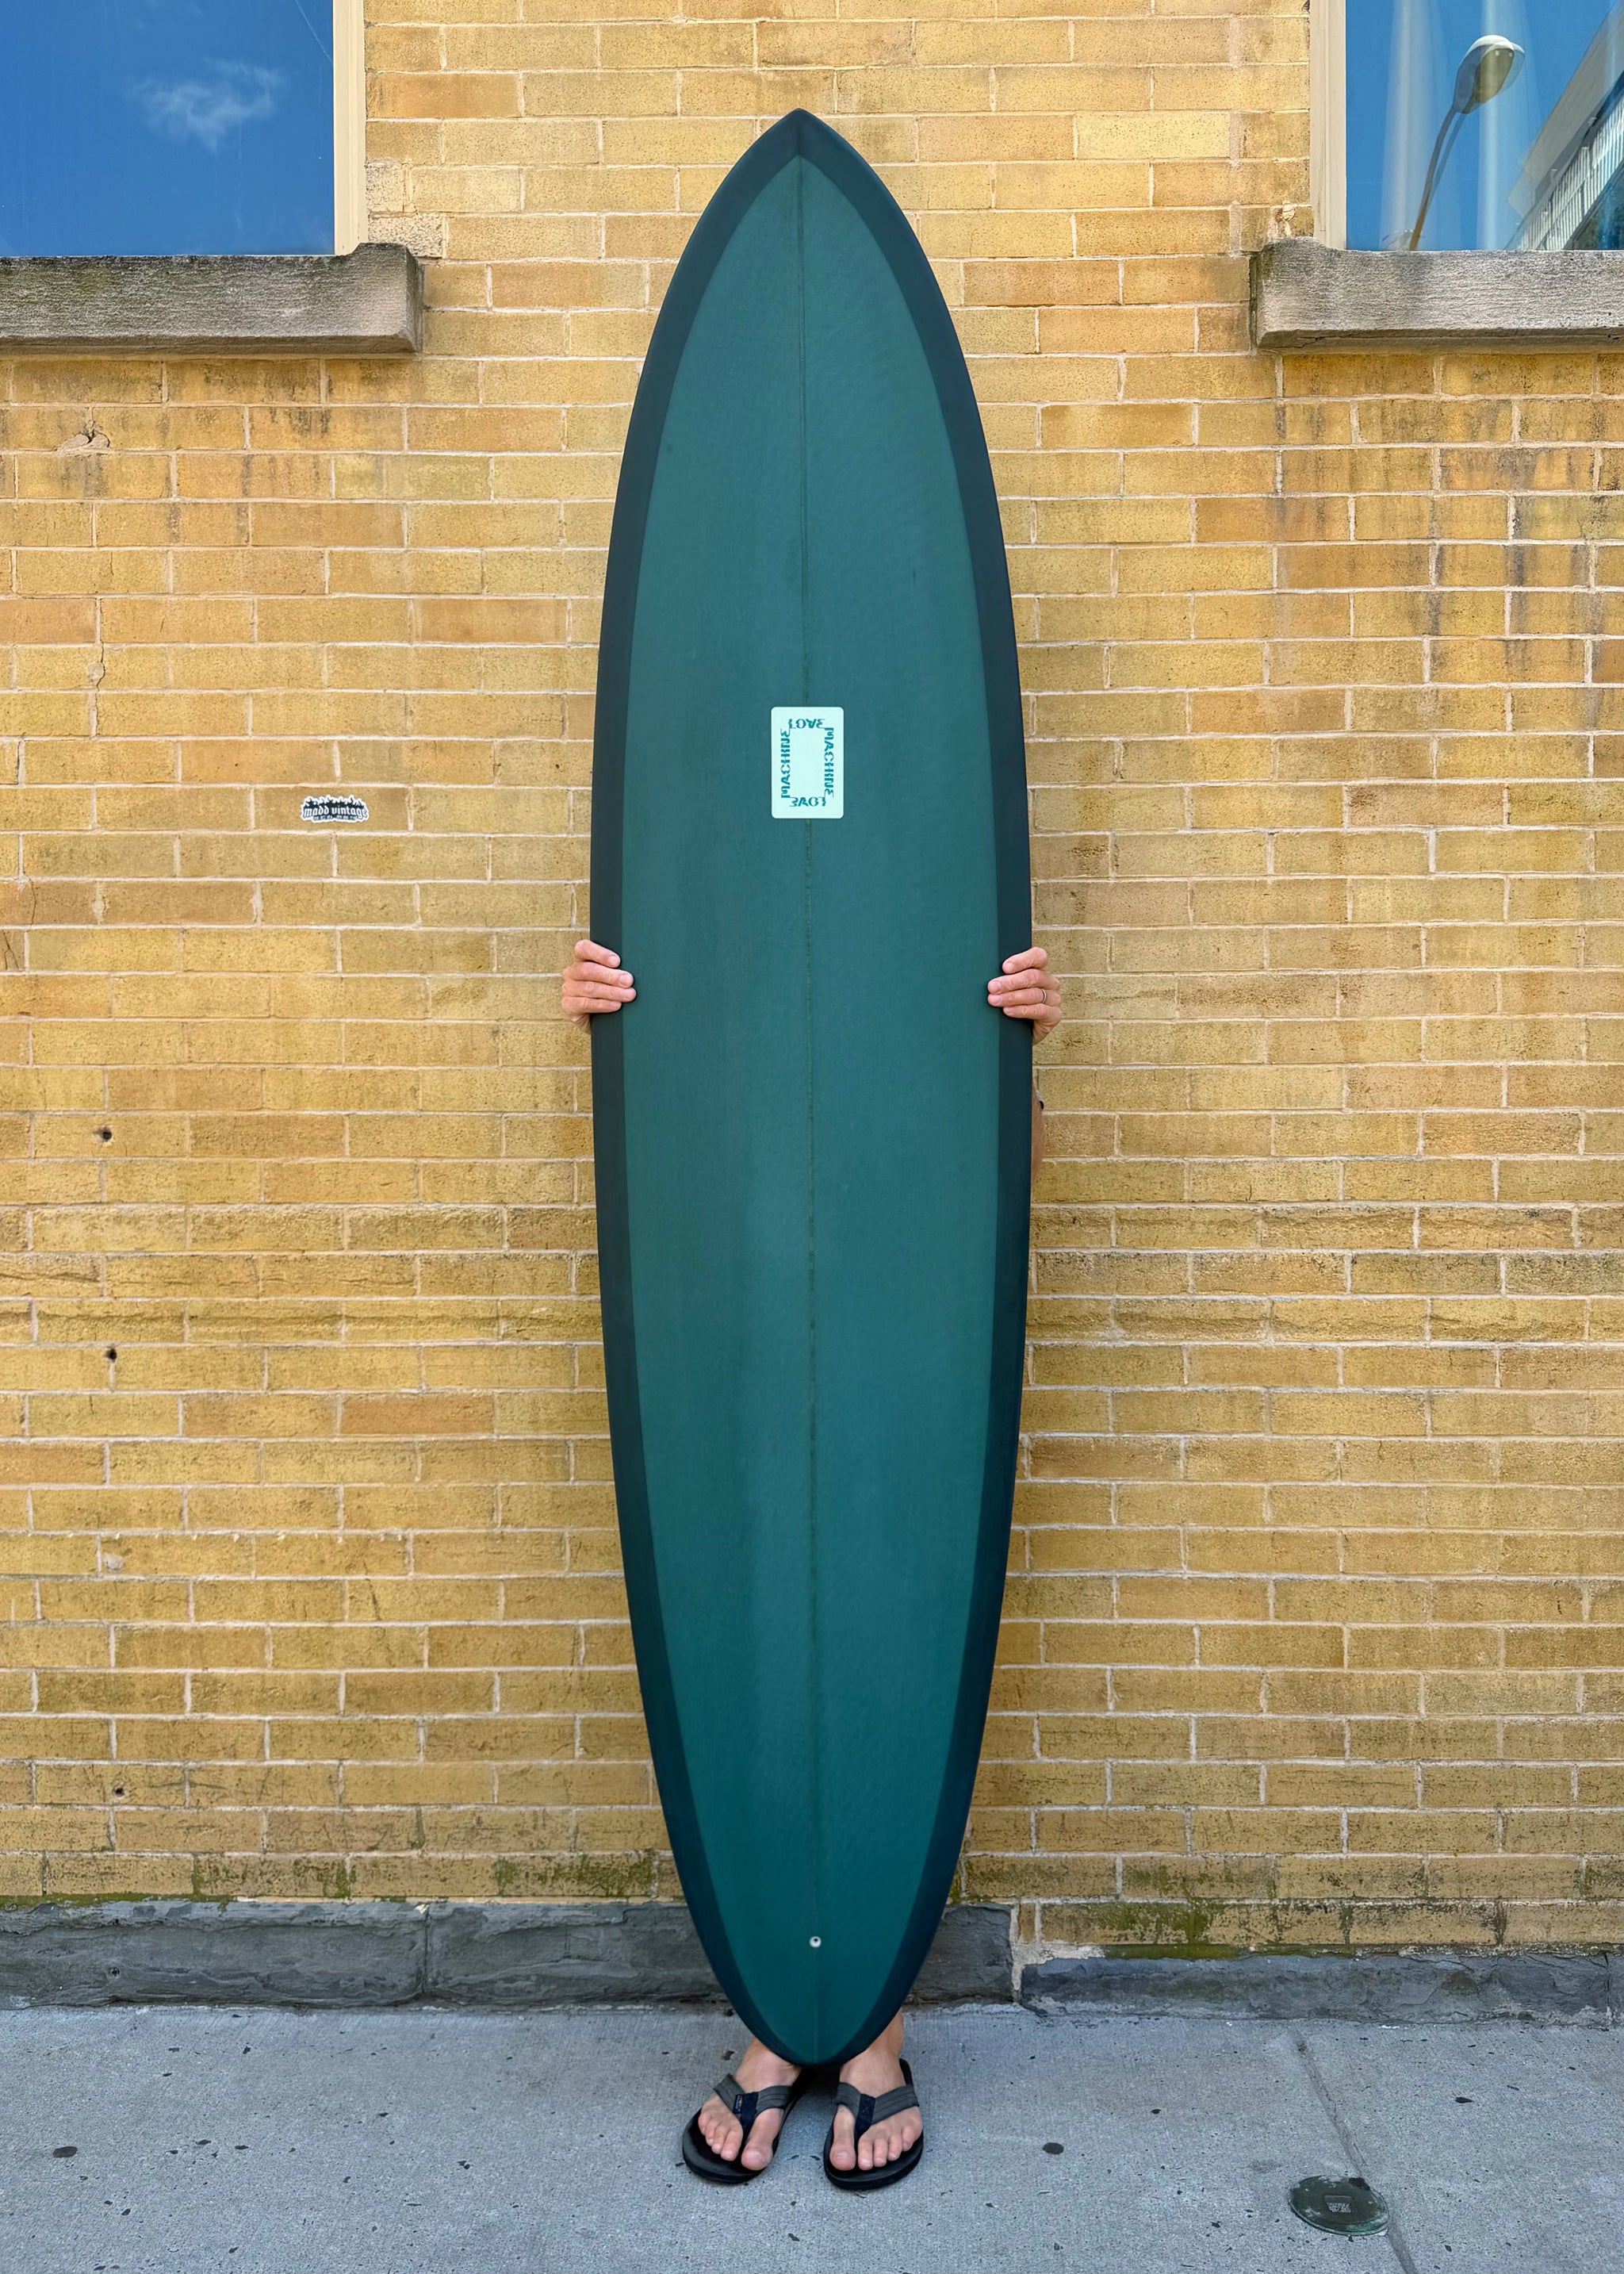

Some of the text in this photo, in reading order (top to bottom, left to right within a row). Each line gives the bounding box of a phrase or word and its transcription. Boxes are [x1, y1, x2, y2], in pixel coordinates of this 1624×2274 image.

[788, 719, 825, 729] LOVE
[780, 728, 791, 798] MACHINE
[825, 727, 834, 797] MACHINE
[789, 796, 826, 807] LOVE
[304, 805, 329, 817] madd
[331, 805, 368, 819] vintage
